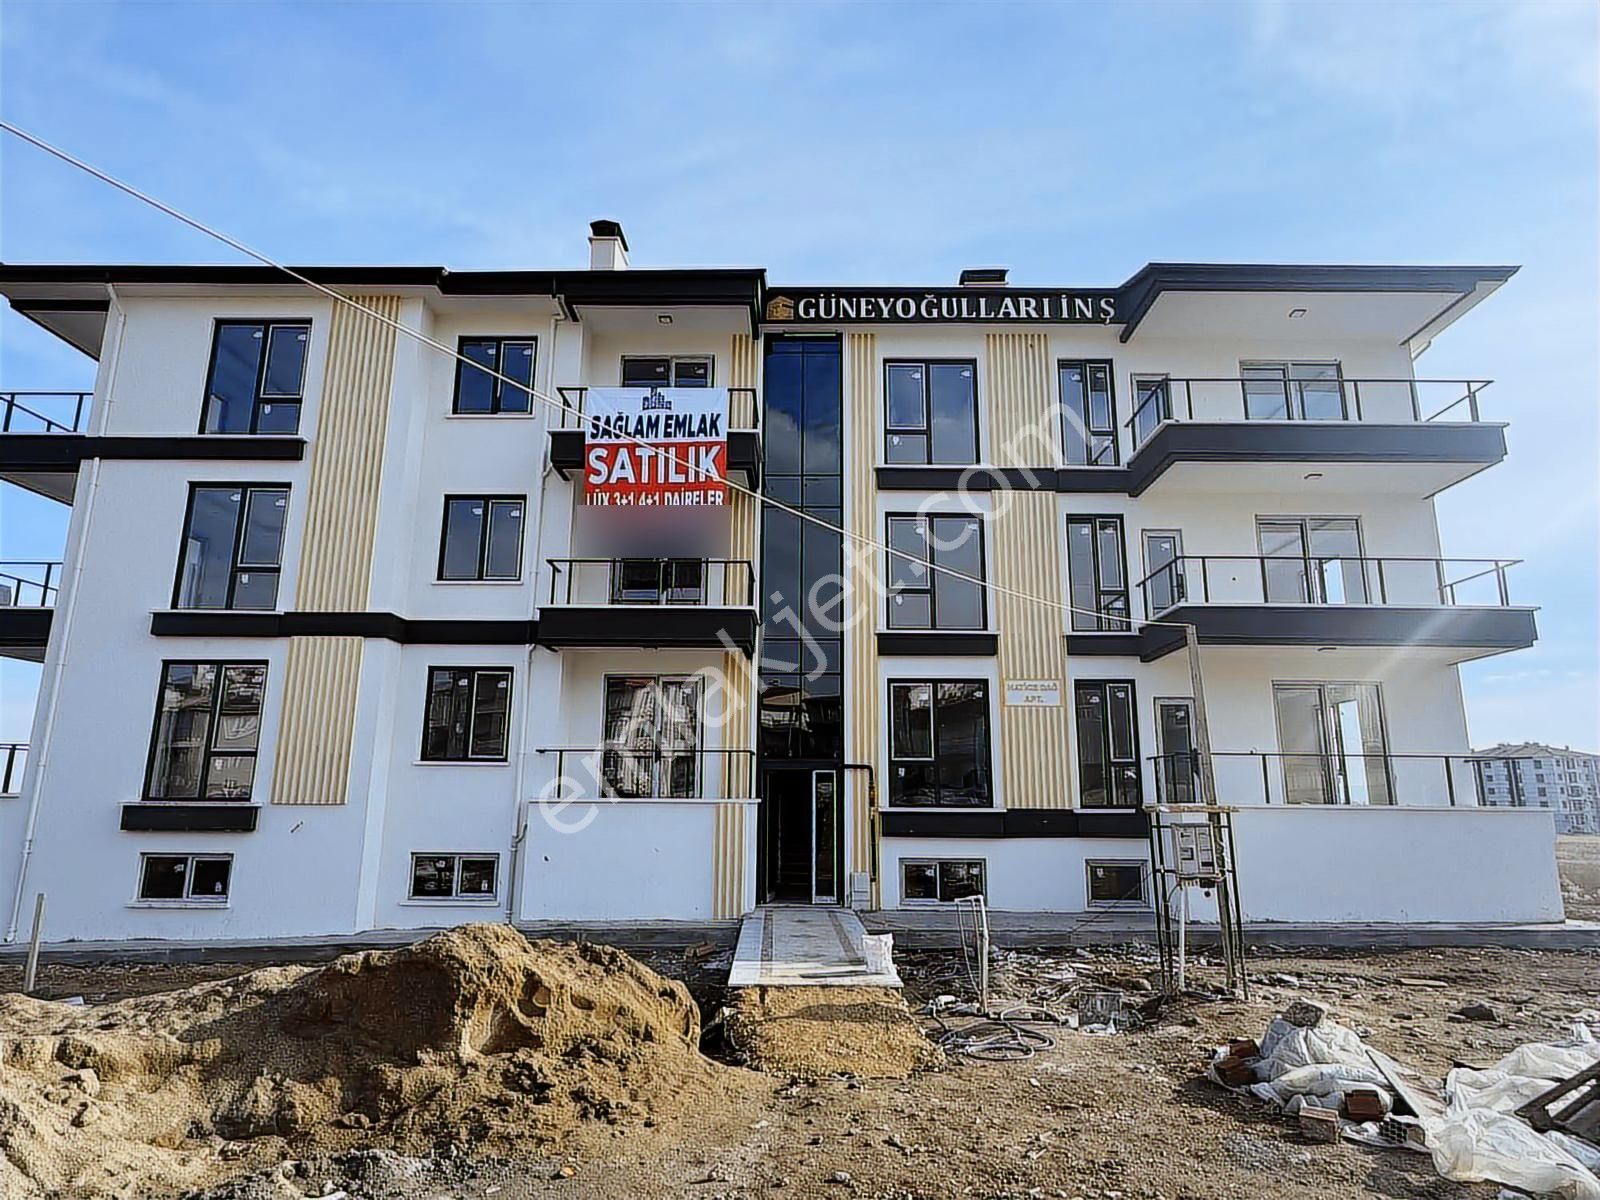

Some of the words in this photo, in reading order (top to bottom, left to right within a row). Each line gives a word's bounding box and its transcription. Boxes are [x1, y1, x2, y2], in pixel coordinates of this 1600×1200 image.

[798, 293, 1052, 320] GÜNEYOĞULLARI
[590, 411, 660, 439] SAĞLAM
[663, 413, 721, 438] EMLAK
[588, 445, 721, 485] SATILIK
[613, 491, 635, 506] 3+1
[638, 491, 660, 506] 4+1
[664, 487, 724, 506] DAİRELER
